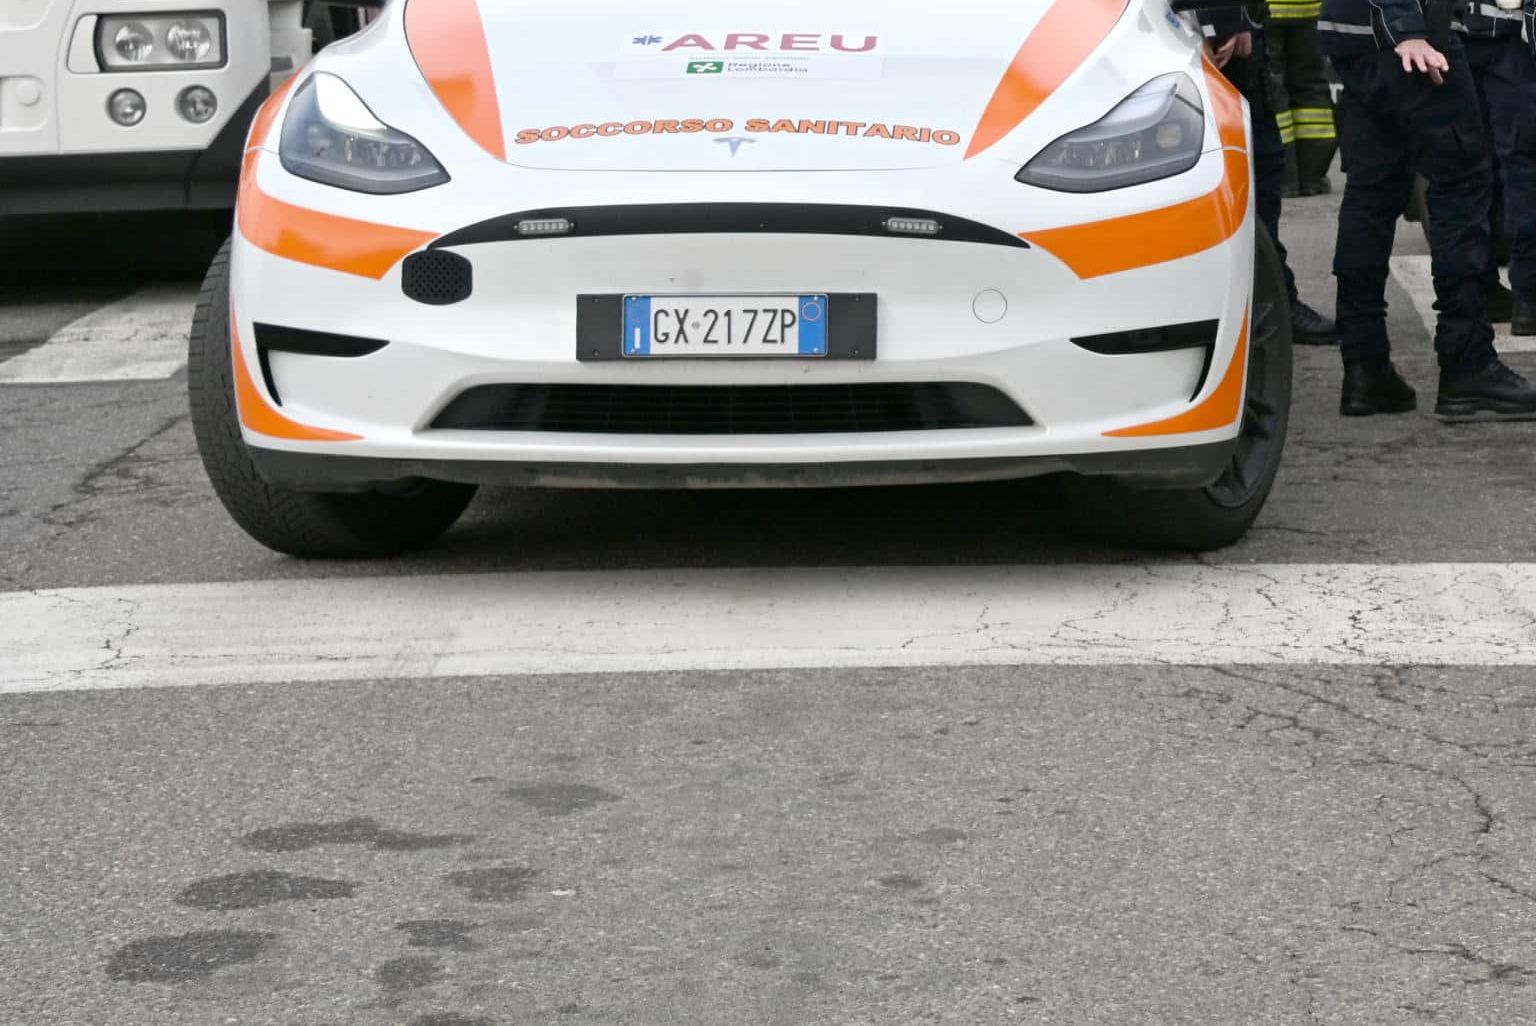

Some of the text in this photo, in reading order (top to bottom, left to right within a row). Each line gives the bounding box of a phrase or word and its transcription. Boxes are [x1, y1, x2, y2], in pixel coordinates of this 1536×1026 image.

[661, 33, 877, 52] AREU
[515, 118, 961, 145] SOCCORSO SANITARIO
[653, 308, 689, 345] GX
[703, 308, 797, 345] 217ZP
